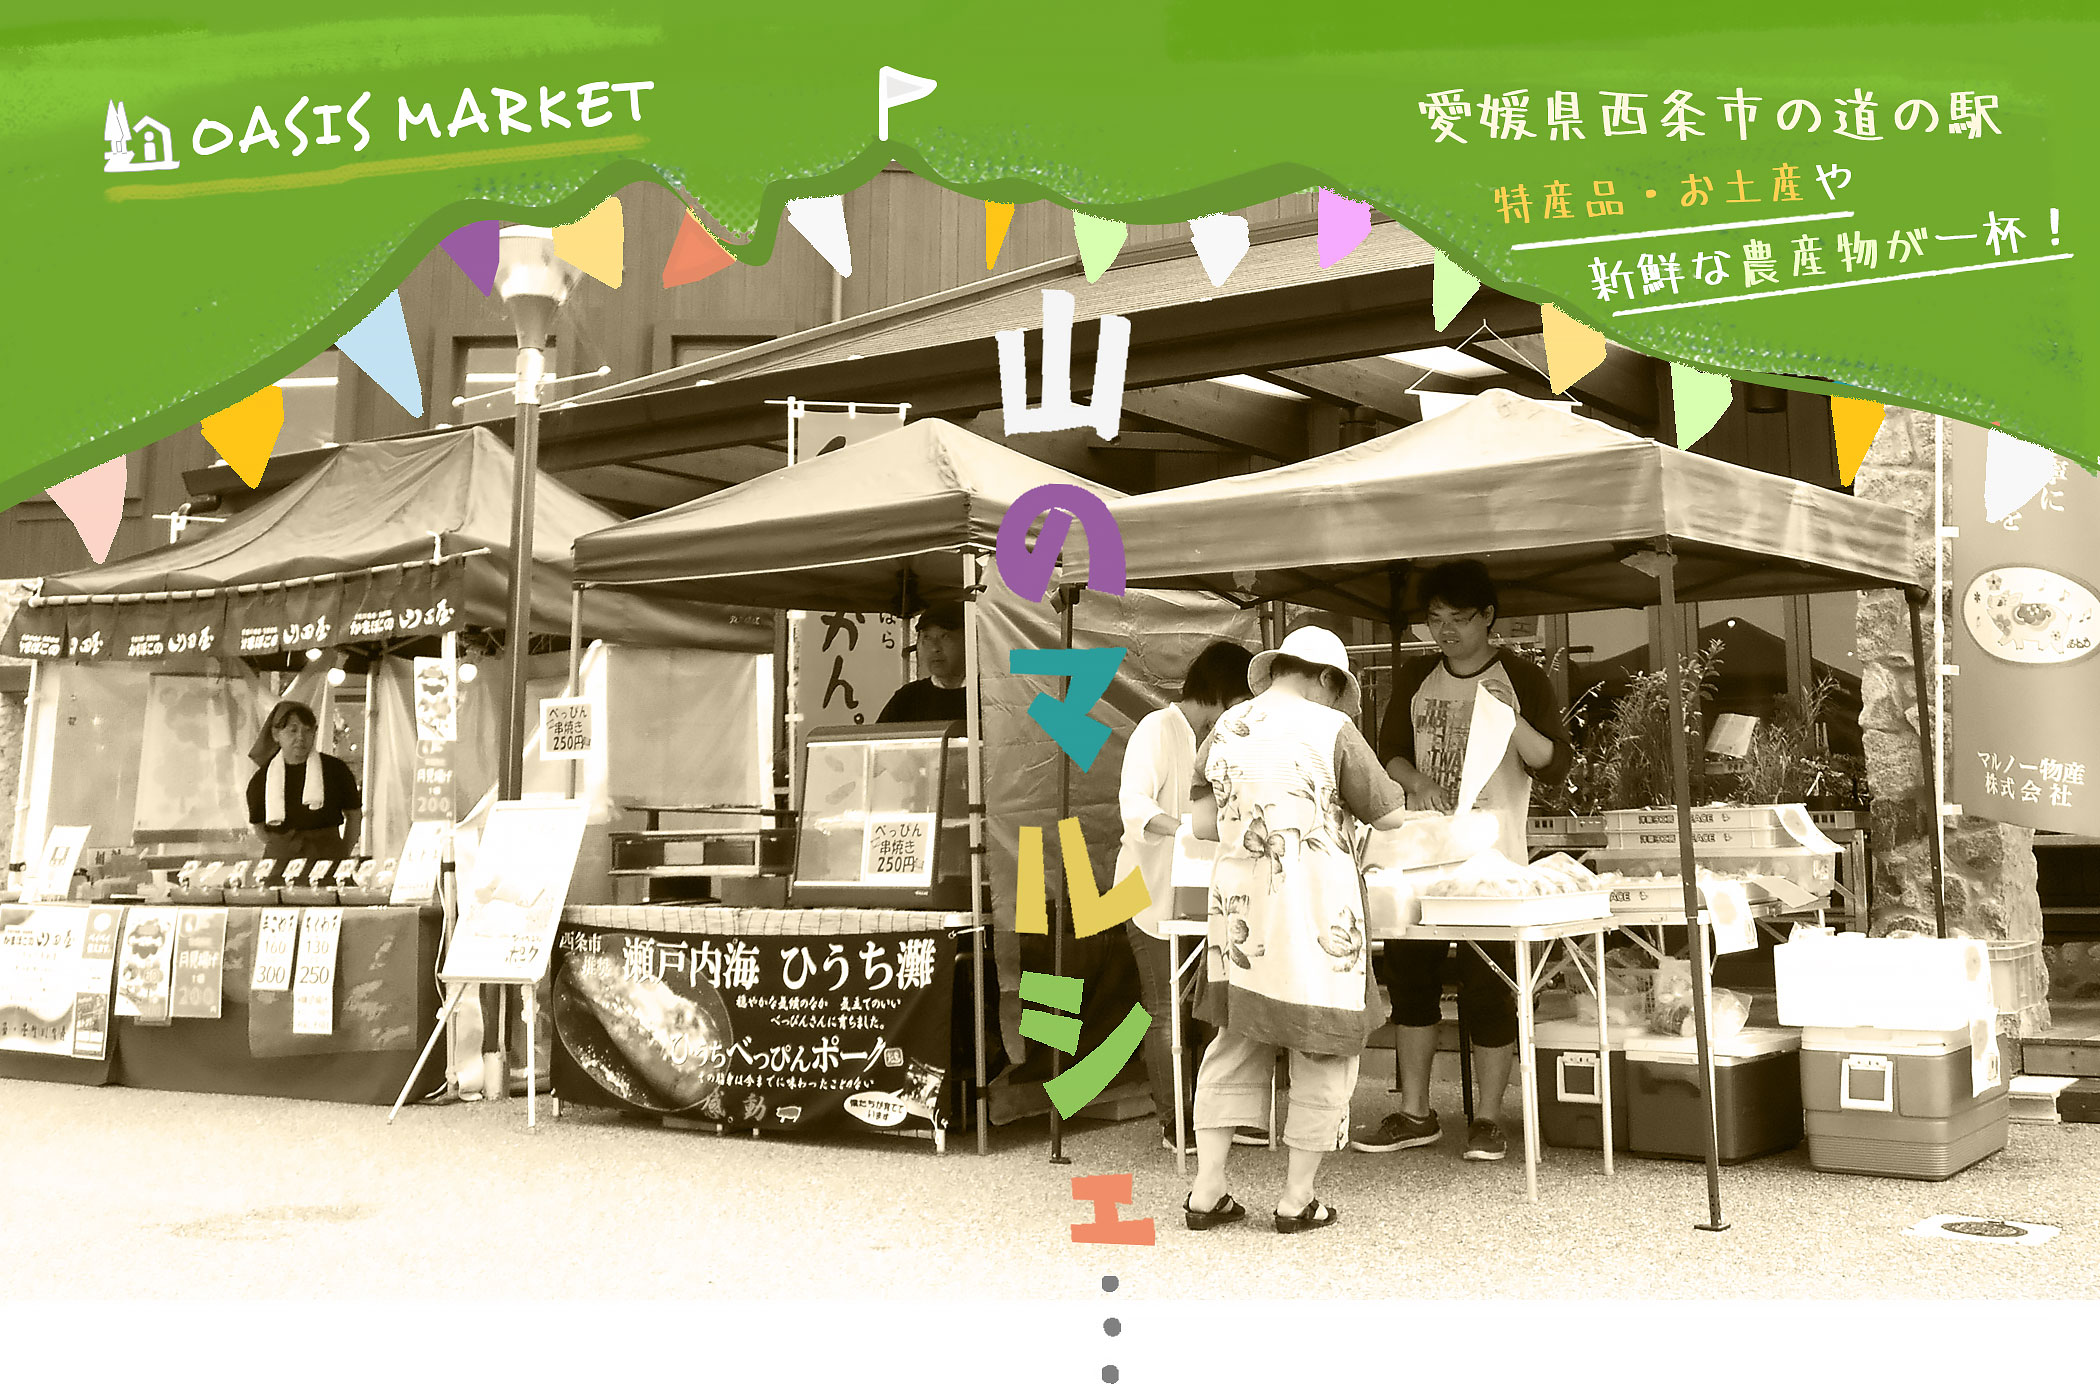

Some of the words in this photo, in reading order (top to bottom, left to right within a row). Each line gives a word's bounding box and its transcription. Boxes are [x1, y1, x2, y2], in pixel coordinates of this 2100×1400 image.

[554, 721, 583, 735] 串焼き
[553, 735, 584, 751] 250円
[1977, 751, 2086, 785] マルノー物産
[1985, 772, 2072, 807] 株式会社
[880, 839, 915, 855] 串焼き
[877, 855, 915, 873] 250円
[307, 940, 329, 954] 130
[559, 931, 602, 954] 西条市
[622, 936, 760, 990] 瀬戸内海
[781, 938, 937, 991] ひうち灘
[257, 965, 286, 984] 300
[300, 966, 329, 984] 250
[669, 1035, 886, 1073] ひうちべっぴんポーク
